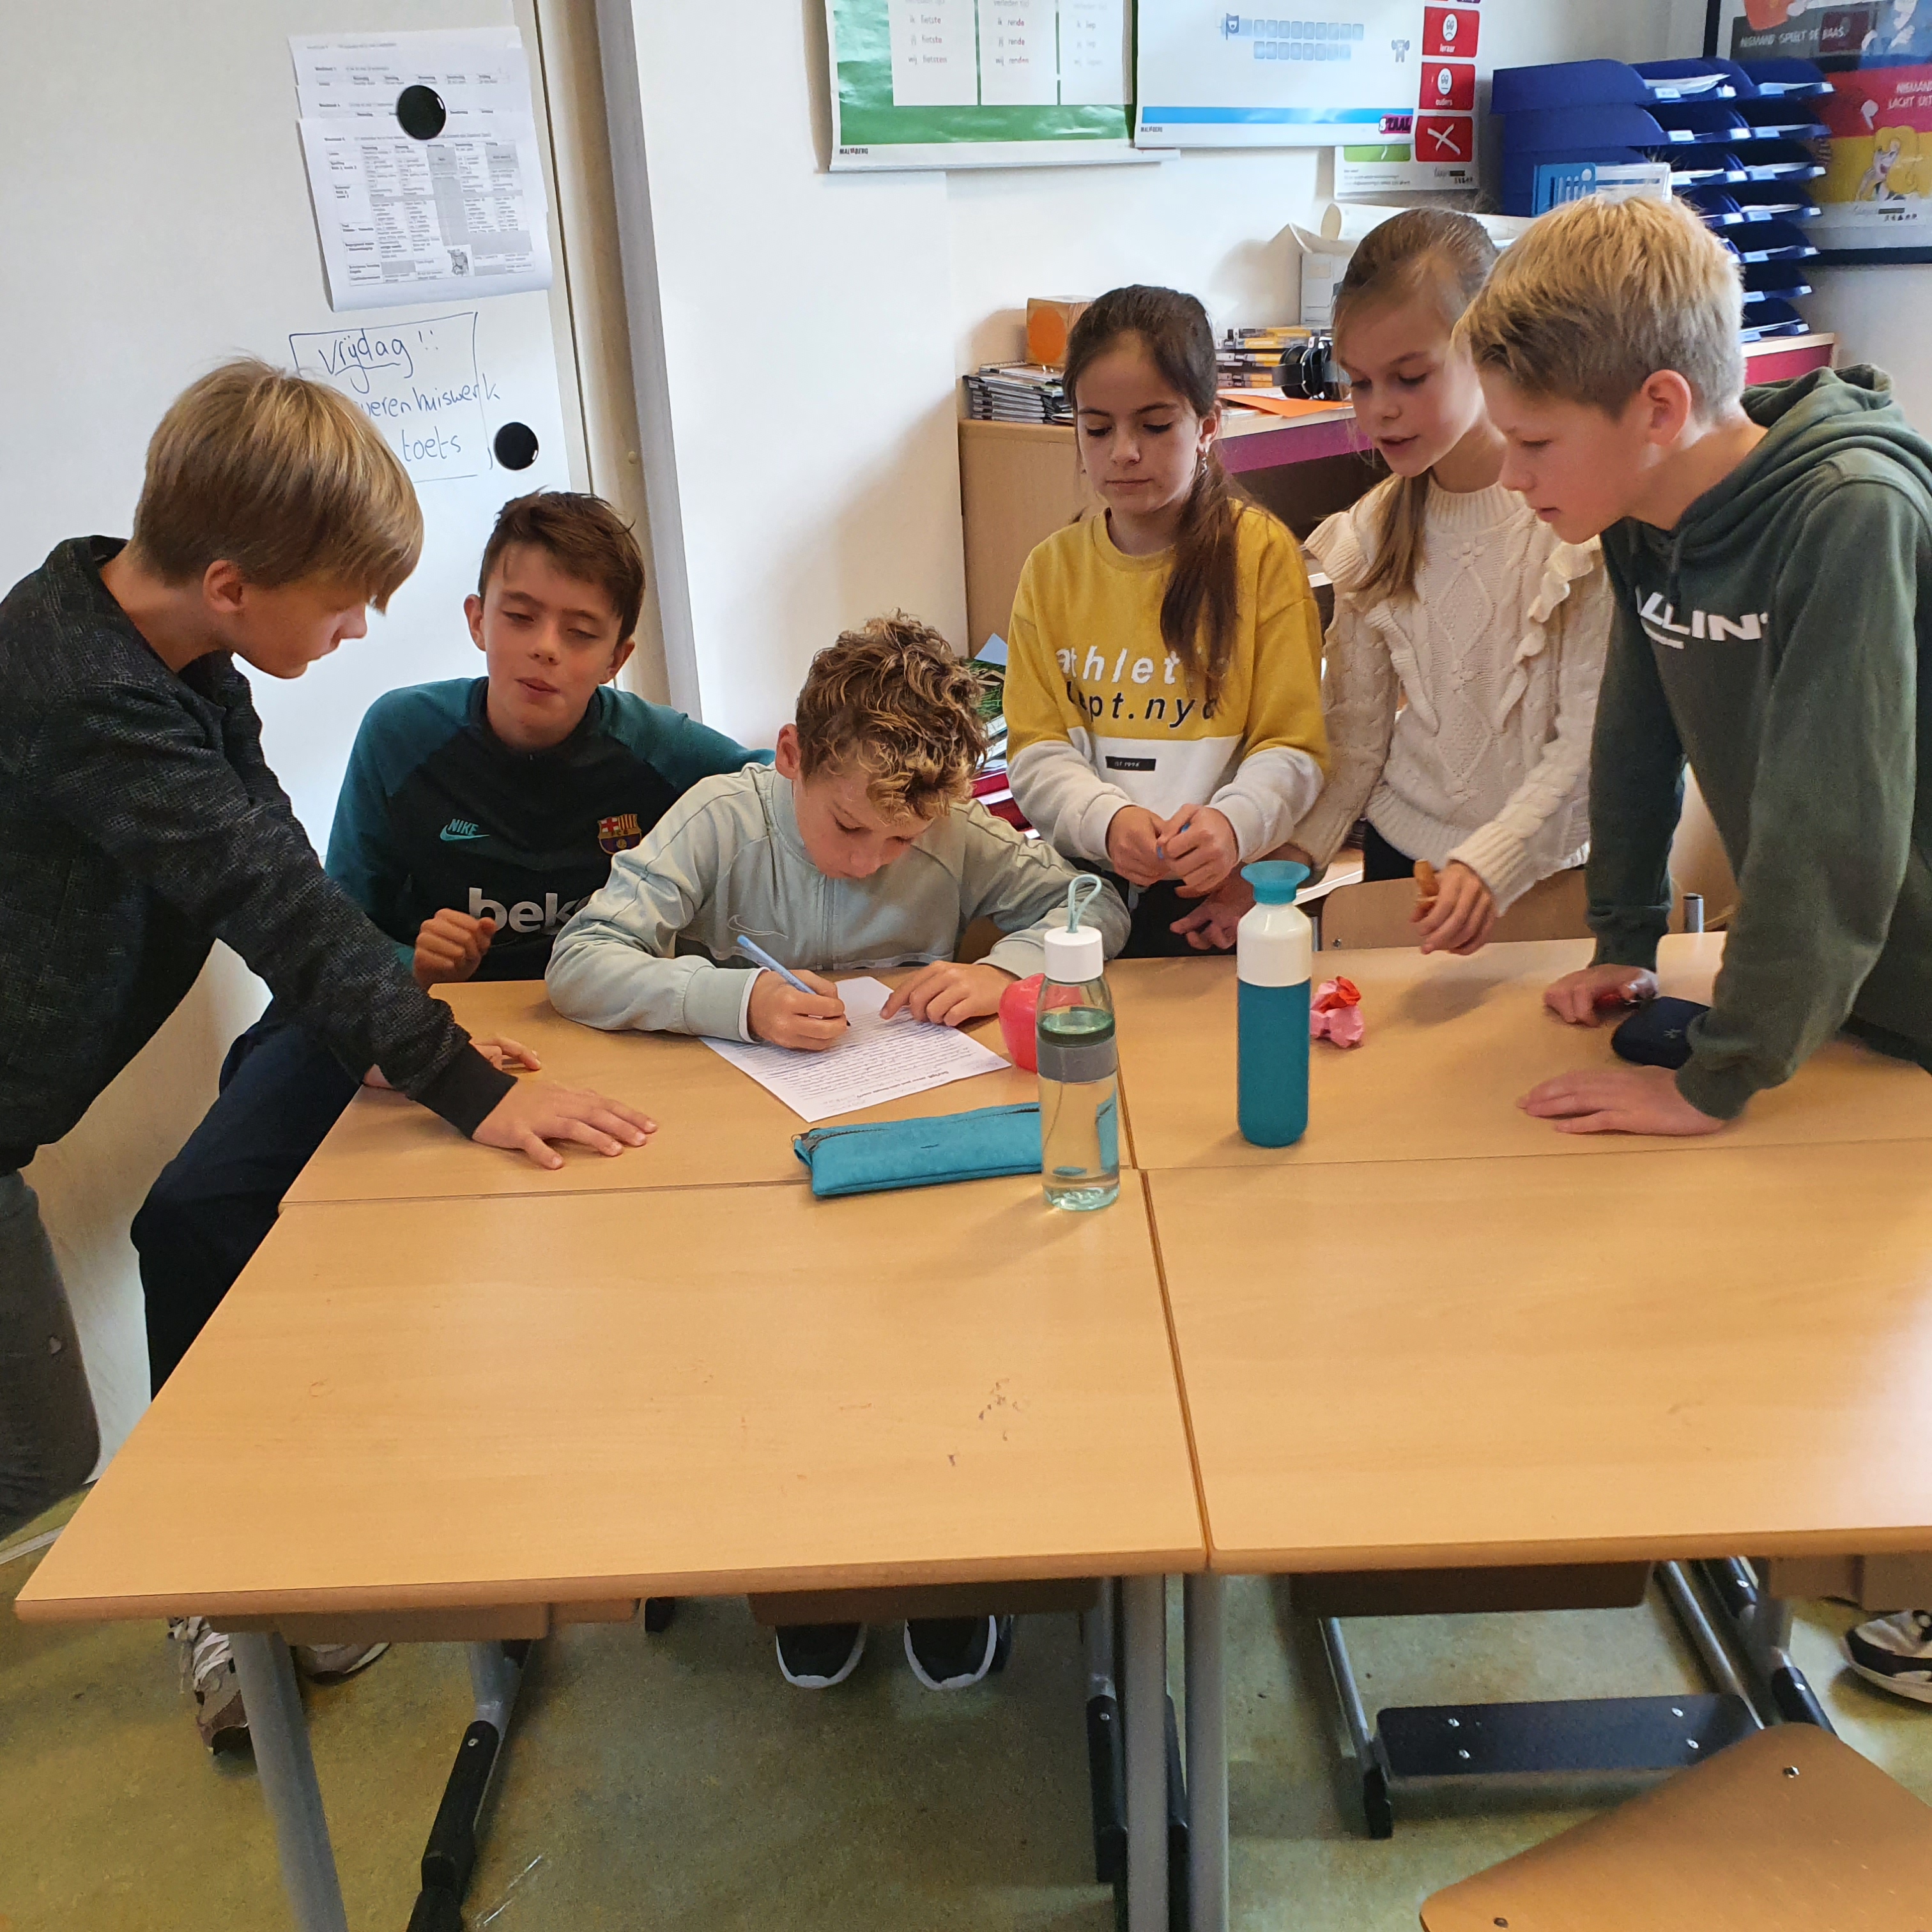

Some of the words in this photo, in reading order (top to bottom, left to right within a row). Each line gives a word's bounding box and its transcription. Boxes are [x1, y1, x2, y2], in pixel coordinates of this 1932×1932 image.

[1007, 18, 1025, 27] rende
[1008, 36, 1025, 46] rende
[1008, 56, 1029, 65] renden
[401, 425, 462, 463] toets
[448, 818, 480, 836] NIKE
